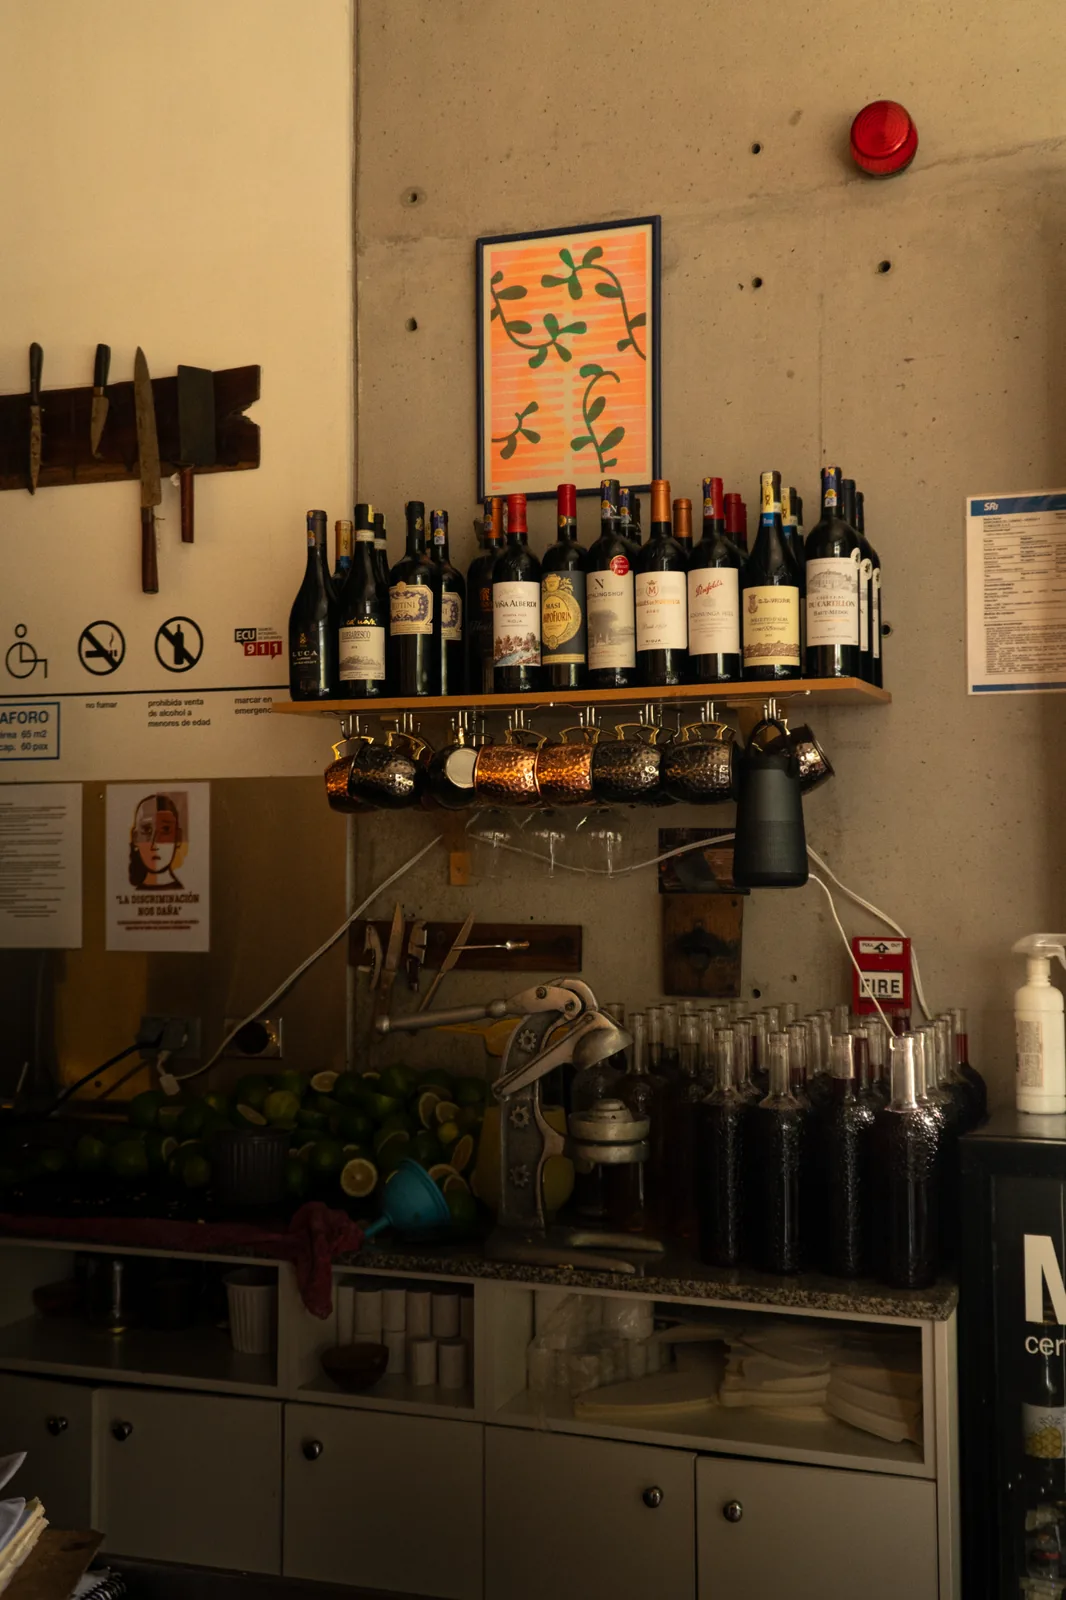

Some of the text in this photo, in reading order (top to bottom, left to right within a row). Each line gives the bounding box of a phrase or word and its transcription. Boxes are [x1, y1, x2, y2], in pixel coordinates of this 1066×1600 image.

[648, 586, 656, 594] M
[236, 631, 255, 641] ECU
[246, 643, 279, 654] 911
[148, 700, 182, 708] prohibida
[0, 711, 48, 724] AFORO
[861, 979, 900, 994] FIRE
